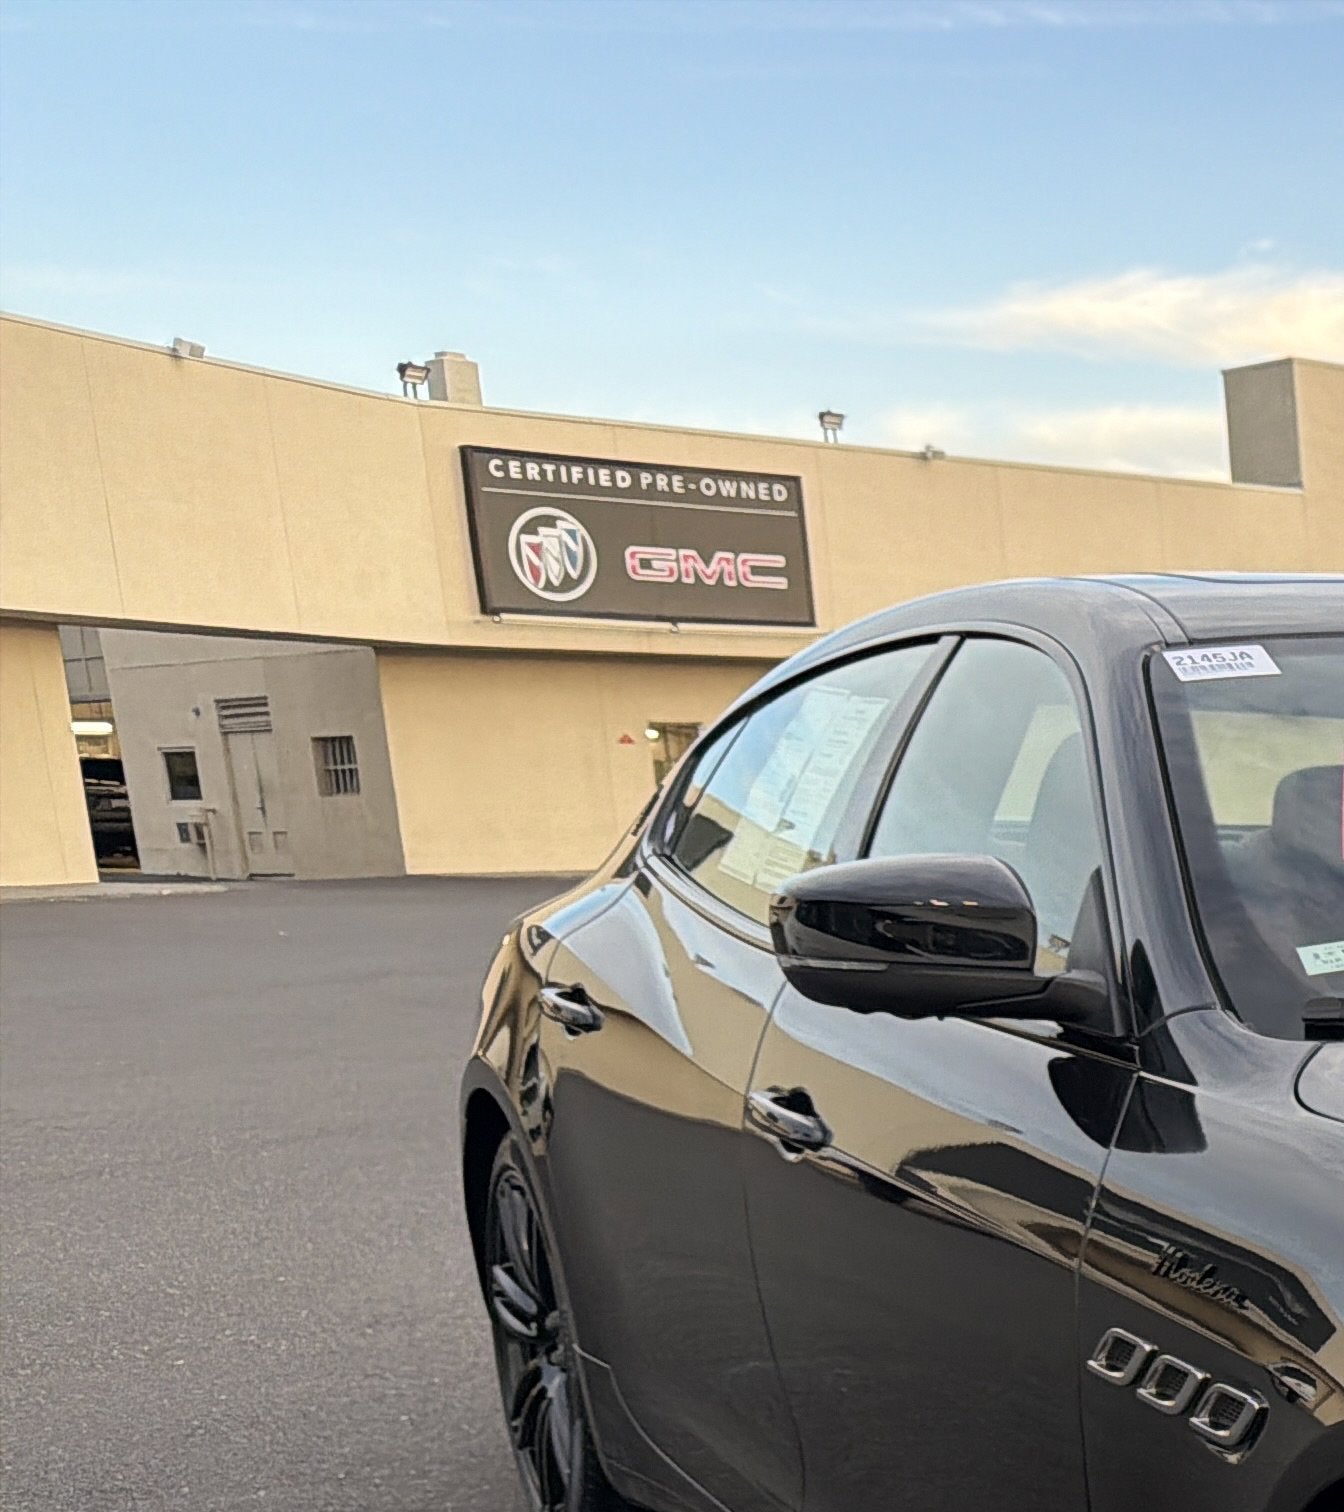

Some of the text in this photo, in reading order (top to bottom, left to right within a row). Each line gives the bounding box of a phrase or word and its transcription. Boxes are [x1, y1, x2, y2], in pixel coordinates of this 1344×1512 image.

[489, 459, 788, 501] CERTIFIED PRE-OWNED
[624, 545, 789, 590] GMC
